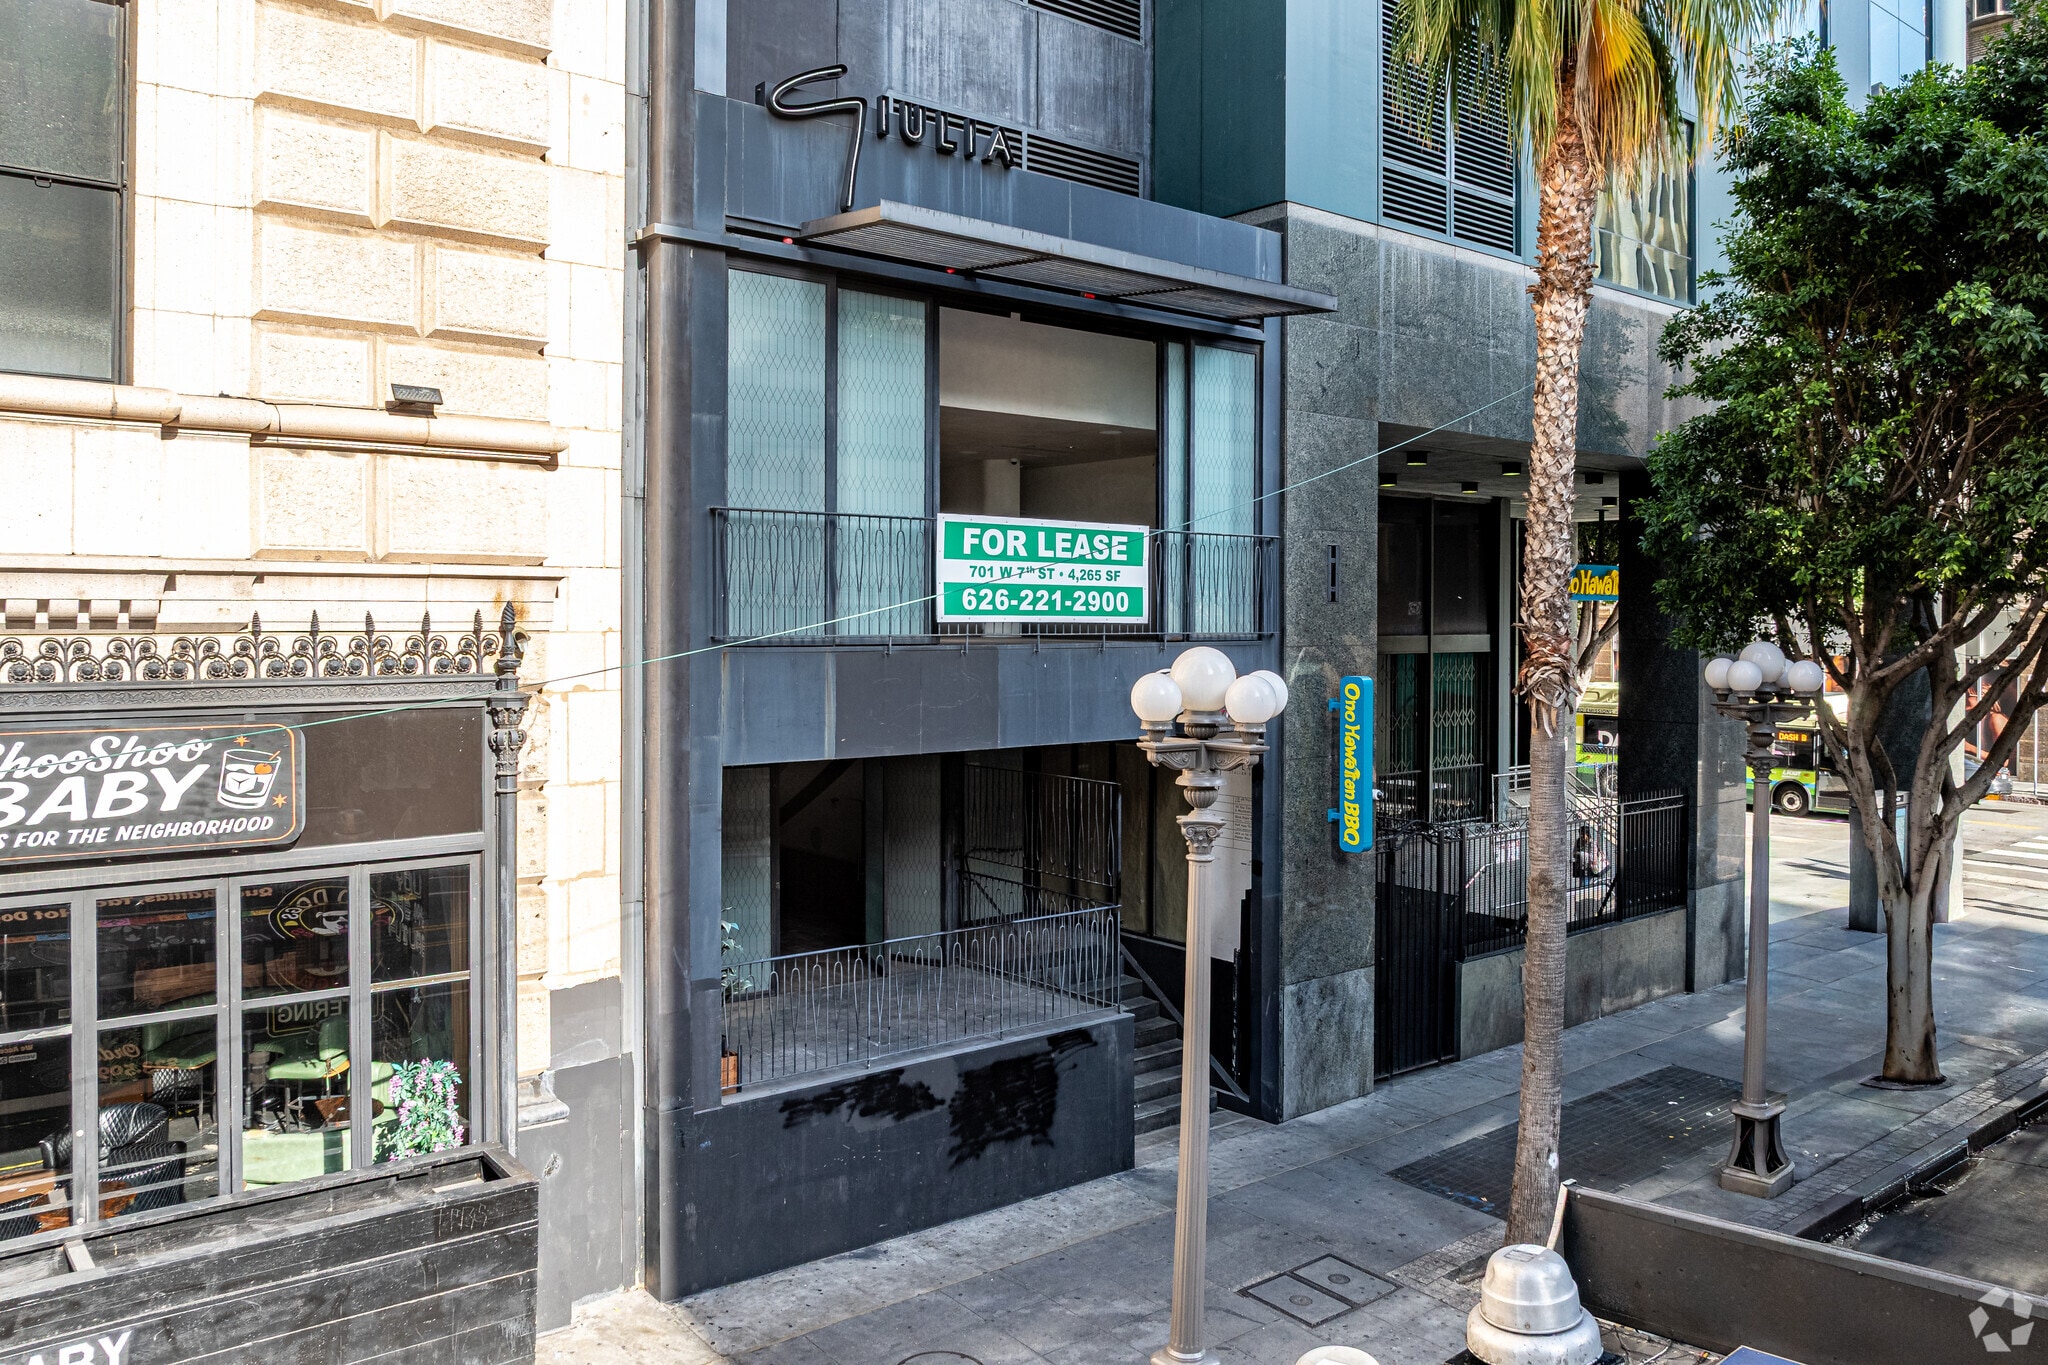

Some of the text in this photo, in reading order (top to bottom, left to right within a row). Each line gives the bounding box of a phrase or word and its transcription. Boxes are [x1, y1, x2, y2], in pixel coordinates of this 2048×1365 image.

[963, 527, 1128, 561] FOR LEASE
[969, 565, 1121, 583] 701 W 7th ST 4,265 SF
[962, 588, 1129, 612] 626-221-2900
[1344, 683, 1361, 722] Ono
[1778, 732, 1799, 742] DASH
[0, 735, 212, 780] hooShoo
[13, 831, 60, 848] FOR
[67, 827, 111, 845] THE
[115, 816, 274, 841] NEIGHBORHOOD
[1343, 801, 1360, 846] BBQ
